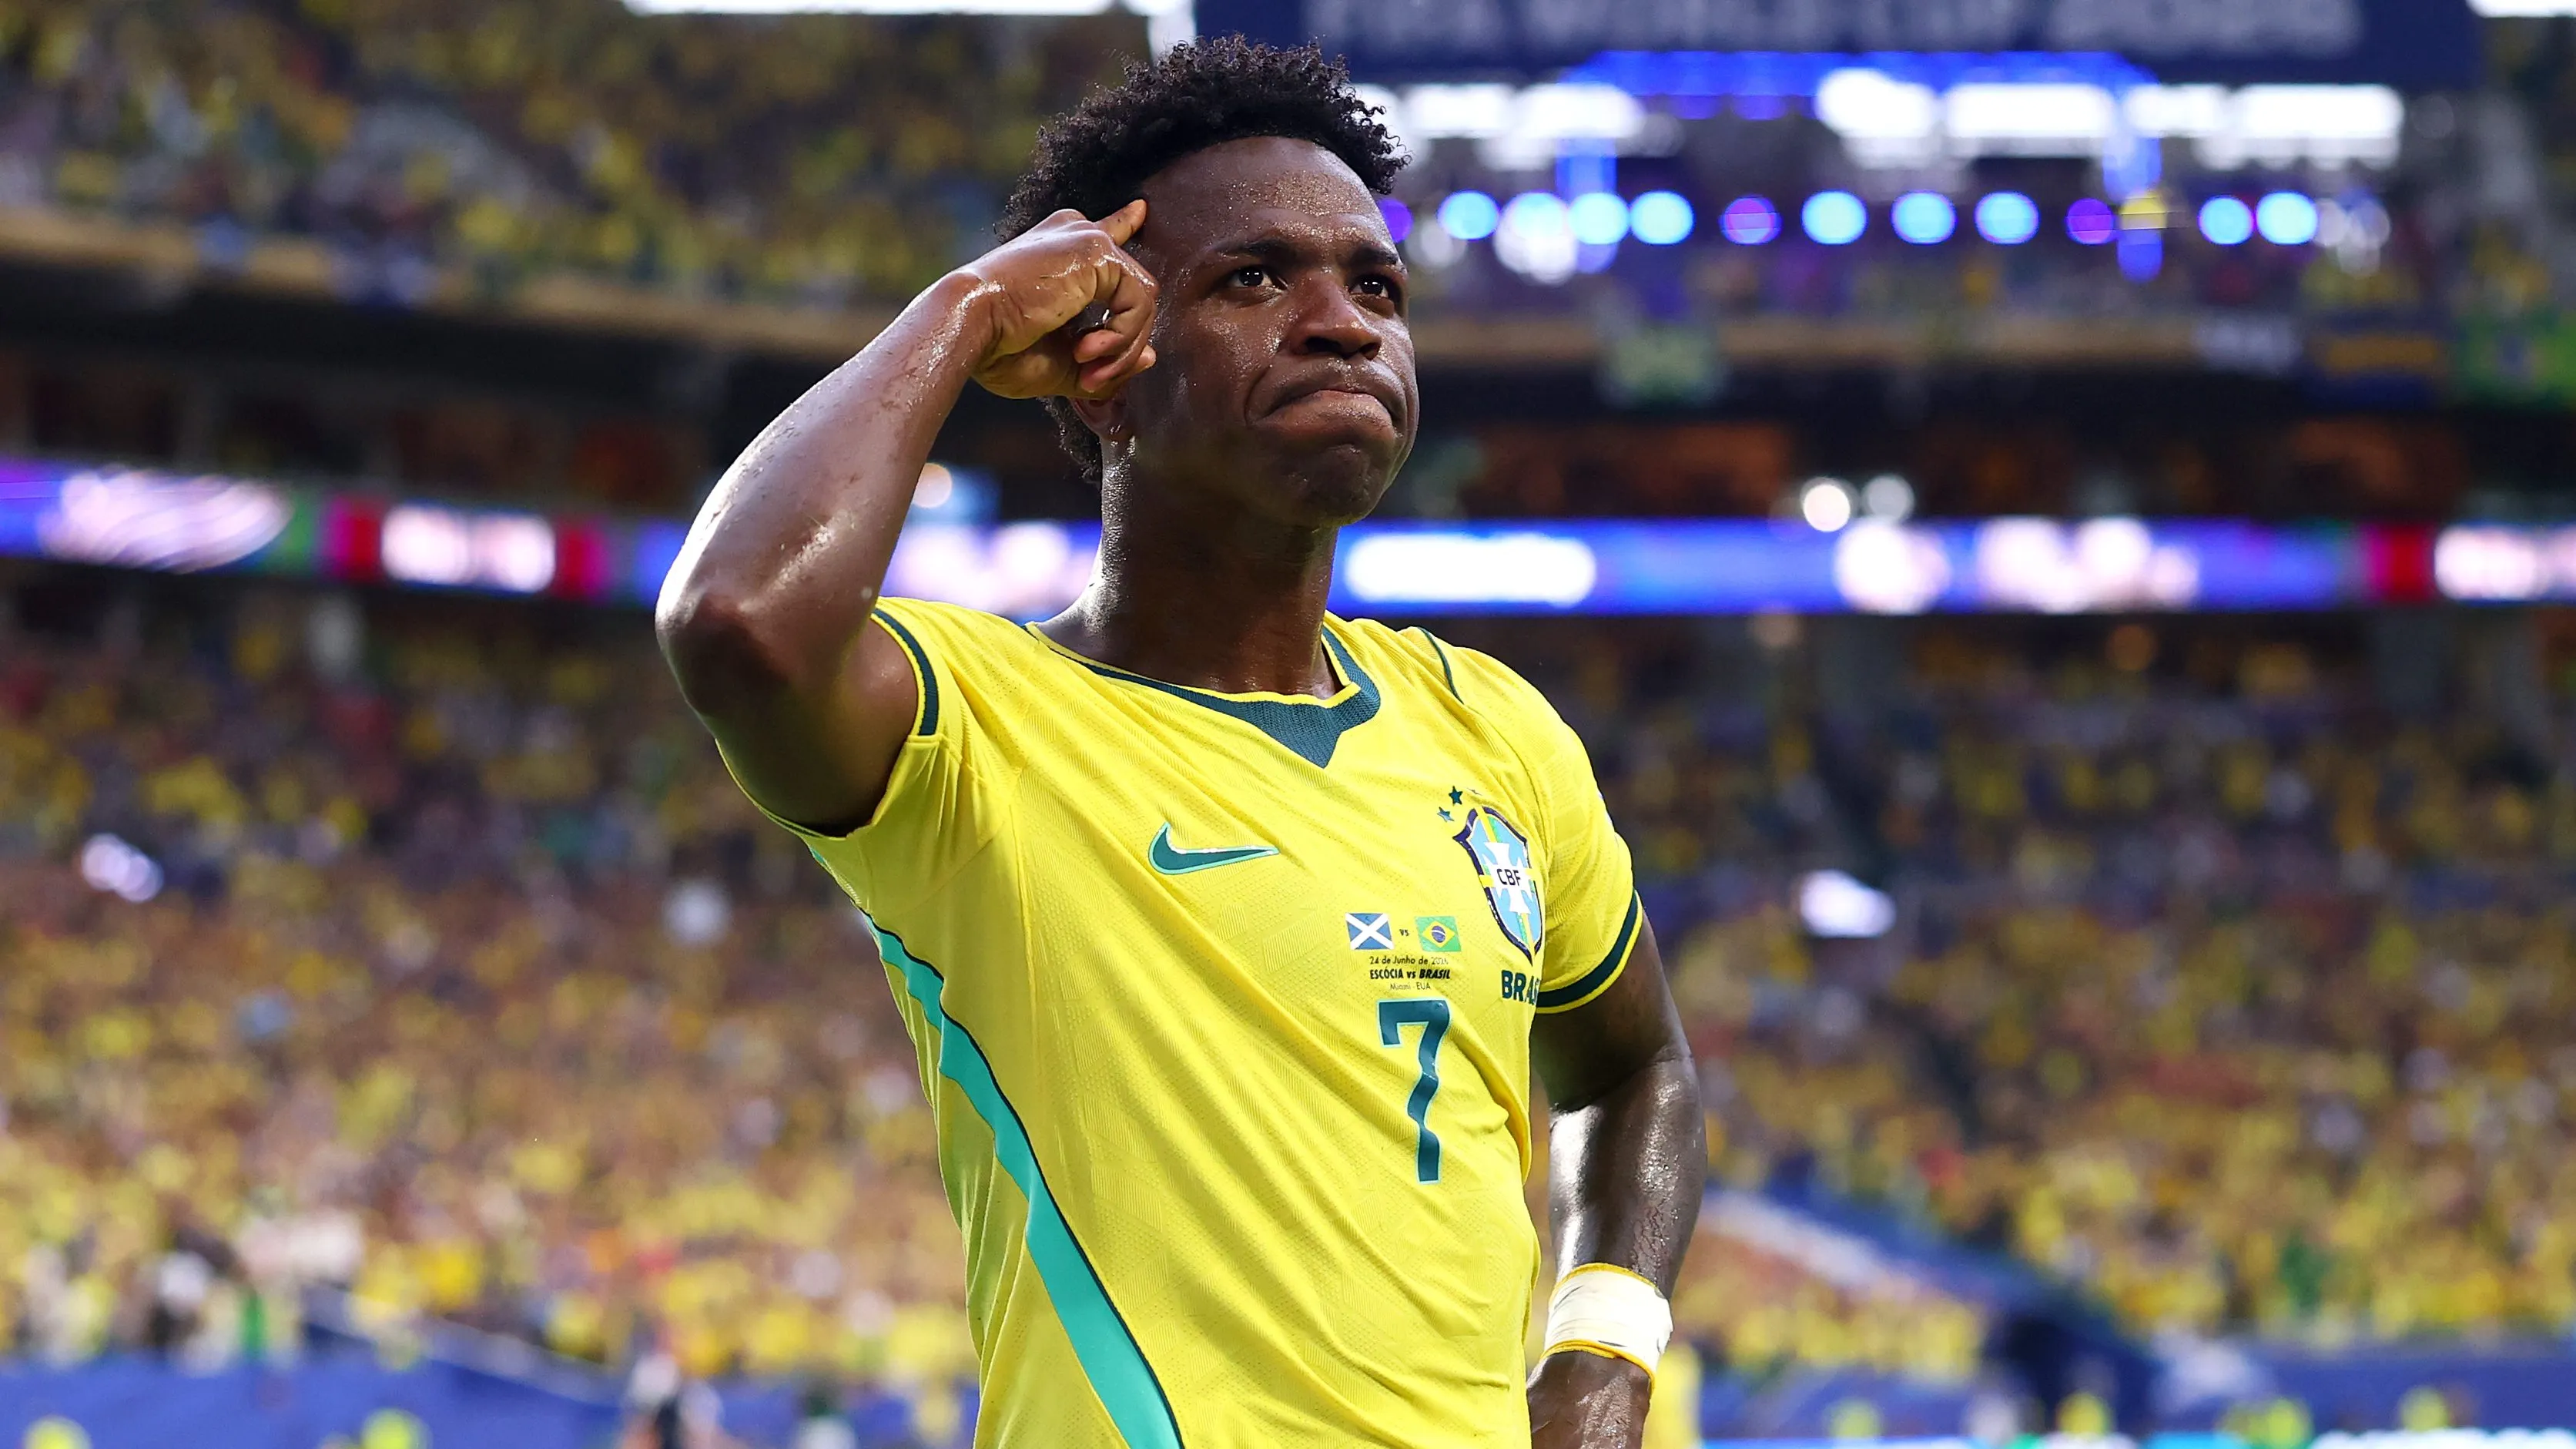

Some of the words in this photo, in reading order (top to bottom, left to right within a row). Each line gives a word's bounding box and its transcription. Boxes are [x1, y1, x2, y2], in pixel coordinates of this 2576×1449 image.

[1496, 868, 1521, 886] CBF
[1370, 955, 1379, 964] 24
[1382, 955, 1391, 964] de
[1392, 955, 1415, 964] Junho
[1419, 956, 1429, 964] de
[1370, 966, 1404, 979] ESCÓCIA
[1406, 971, 1416, 979] vs
[1419, 968, 1451, 979] BRASIL
[1415, 981, 1431, 990] EUA
[1376, 998, 1451, 1184] 7
